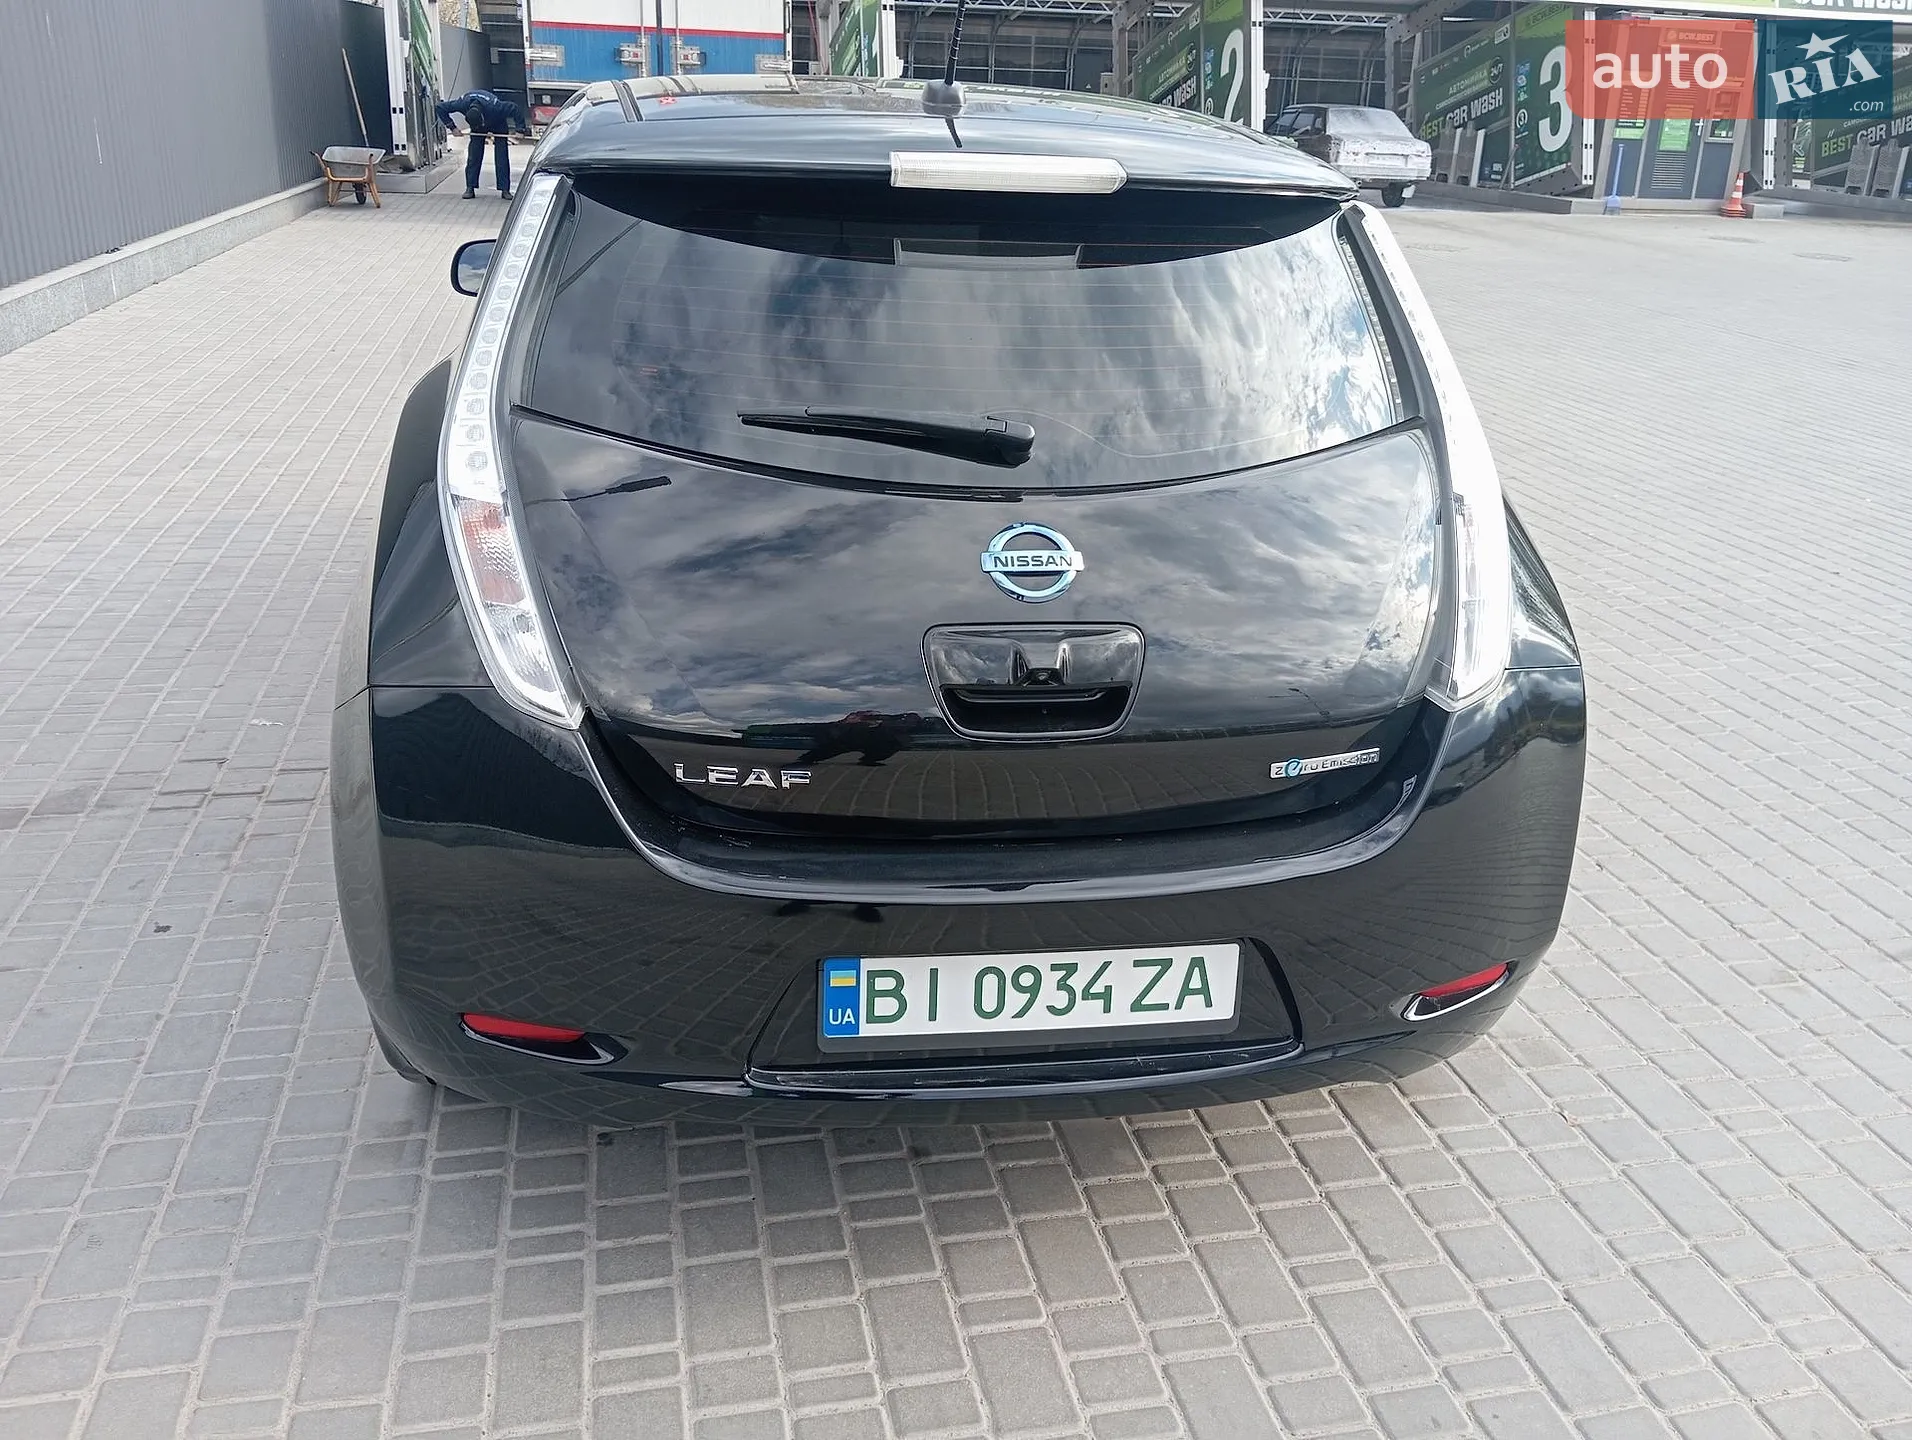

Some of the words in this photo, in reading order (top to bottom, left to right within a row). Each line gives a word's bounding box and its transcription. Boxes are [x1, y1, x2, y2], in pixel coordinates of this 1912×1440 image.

[1220, 28, 1244, 124] 2
[1538, 45, 1573, 152] 3
[1821, 134, 1853, 157] BEST
[993, 555, 1072, 568] NISSAN
[674, 763, 811, 789] LEAF
[866, 967, 939, 1025] BI
[973, 960, 1113, 1020] 0934
[1129, 956, 1213, 1013] ZA
[829, 1008, 855, 1025] UA
